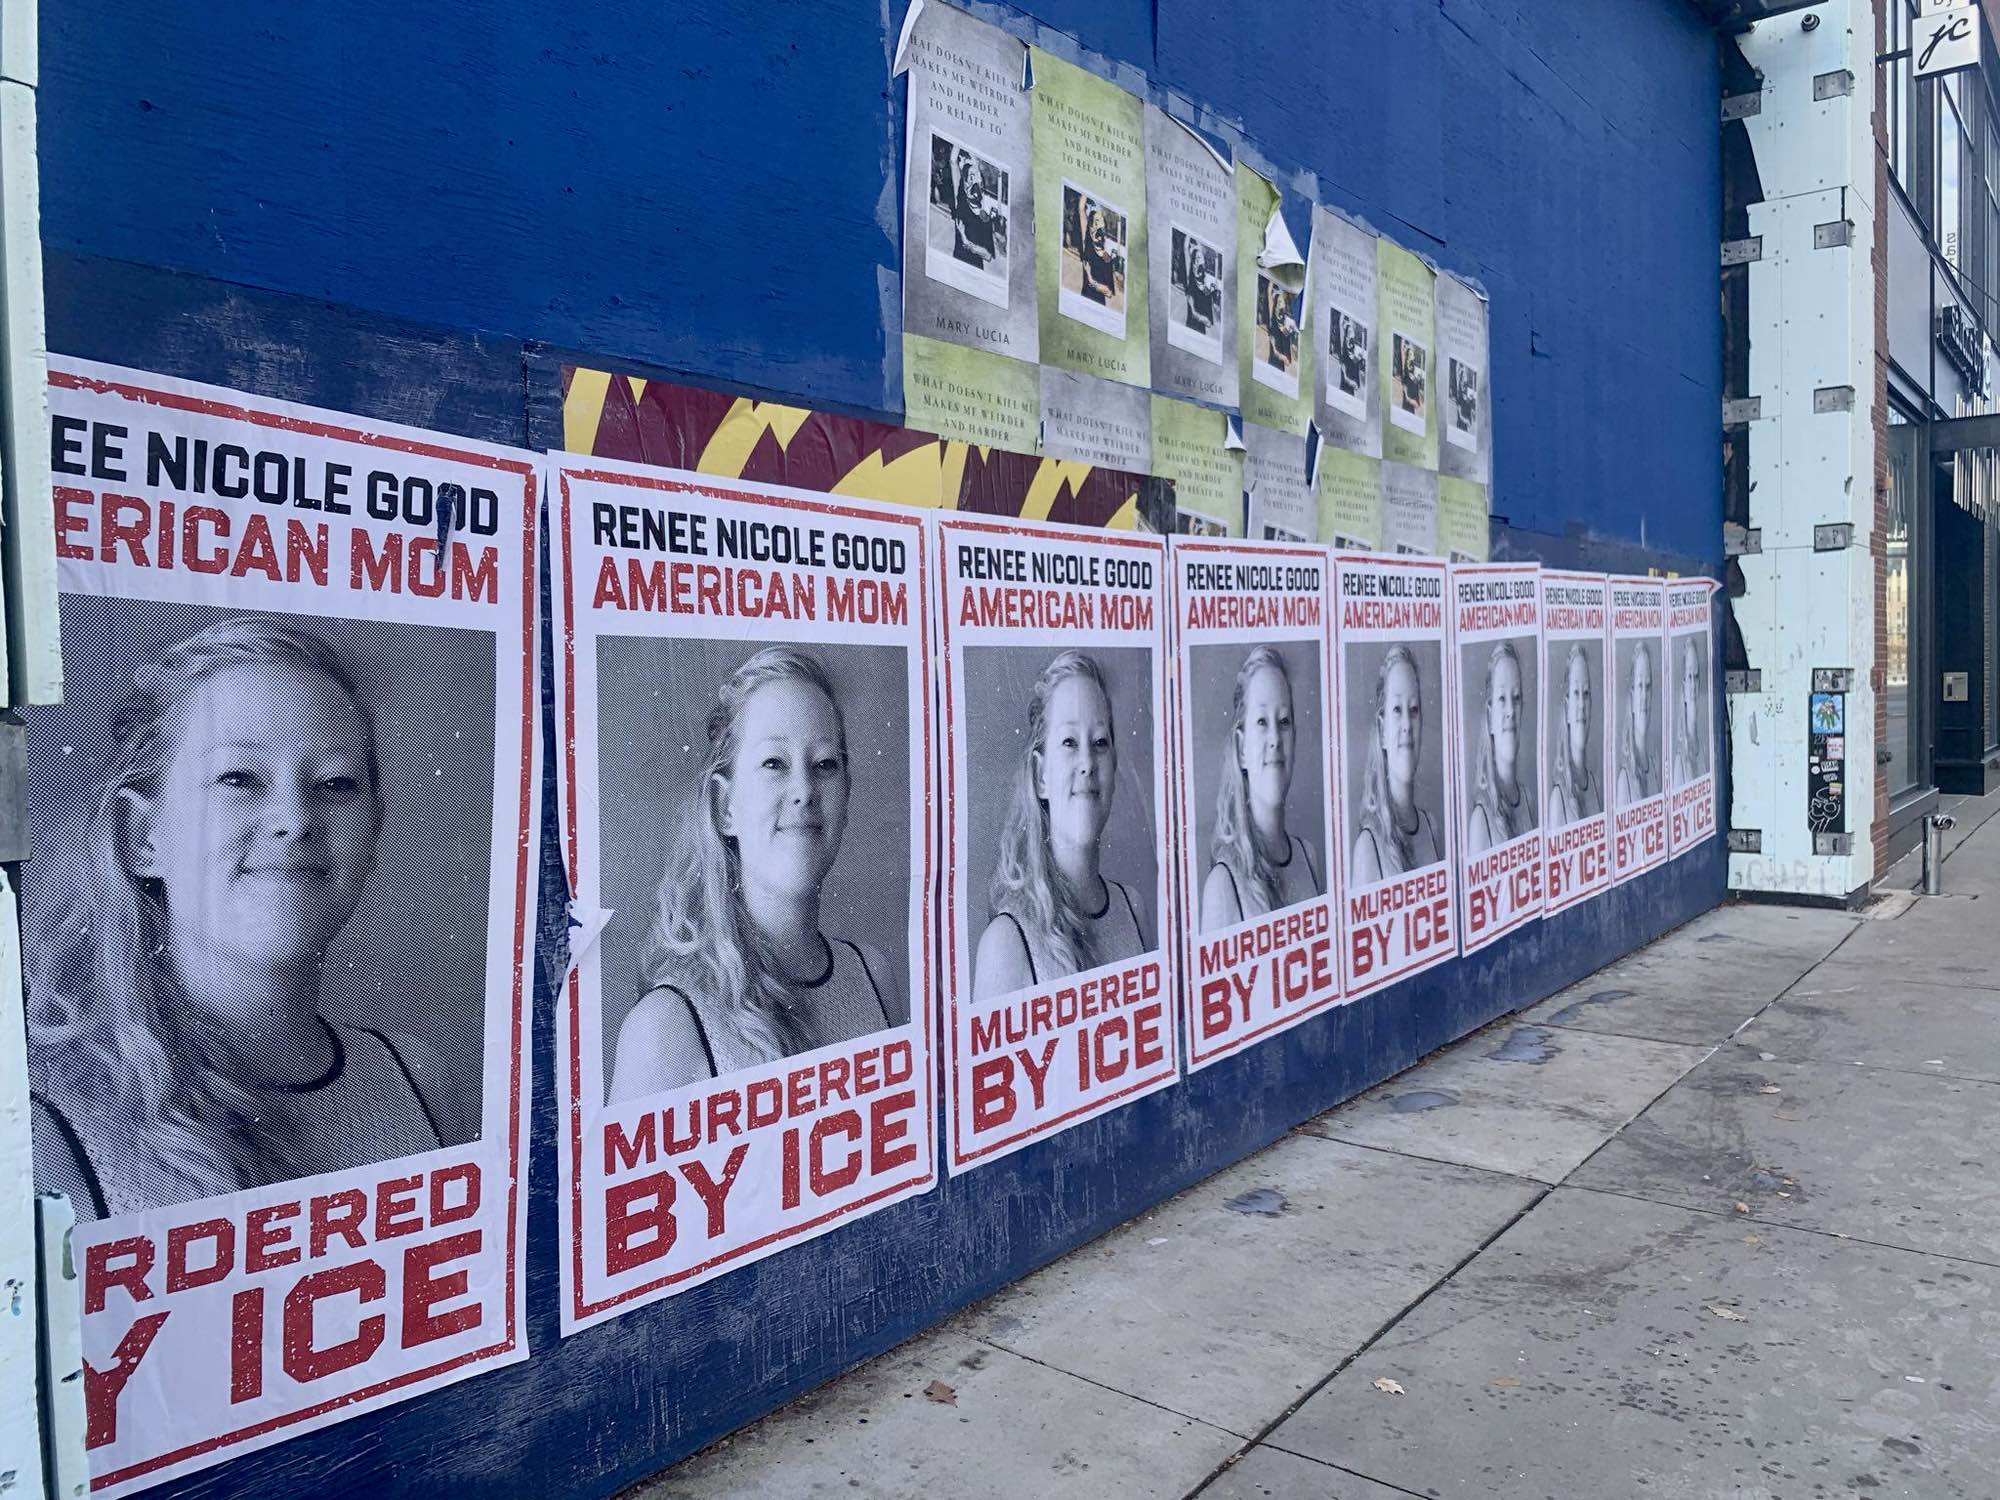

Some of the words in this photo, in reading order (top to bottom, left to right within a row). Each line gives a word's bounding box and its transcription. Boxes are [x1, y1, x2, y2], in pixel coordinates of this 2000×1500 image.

[910, 33, 931, 52] HAT
[936, 46, 981, 75] DOESN'T
[985, 69, 1006, 86] KILL
[911, 52, 947, 78] MAKES
[951, 71, 967, 86] ME
[970, 79, 1016, 109] WEIRDER
[930, 80, 953, 98] AND
[957, 91, 1000, 118] HARDER
[928, 96, 943, 112] TO
[947, 104, 985, 129] RELATE
[989, 122, 1002, 136] TO
[1038, 92, 1064, 112] WHAT
[1048, 113, 1077, 133] MAKES
[1095, 134, 1132, 158] WEIRDER
[1064, 138, 1082, 152] AND
[1084, 146, 1119, 168] HARDER
[1062, 152, 1073, 165] TO
[1076, 158, 1107, 179] RELATE
[1111, 172, 1121, 184] TO
[935, 316, 970, 335] MARY
[975, 326, 1010, 345] LUCIA
[1066, 349, 1095, 364] MARY
[1099, 355, 1127, 373] LUCIA
[913, 372, 944, 391] WHAT
[948, 383, 992, 403] DOESN'T
[996, 396, 1019, 409] KILL
[1021, 400, 1033, 413] ME
[1174, 374, 1197, 388] MARY
[1200, 380, 1224, 395] LUCIA
[923, 394, 960, 412] MAKES
[963, 405, 976, 417] ME
[981, 409, 1025, 428] WEIRDER
[943, 418, 965, 432] AND
[968, 424, 1009, 442] HARDER
[1047, 408, 1073, 421] WHAT
[1076, 415, 1113, 432] DOESN'T
[1056, 426, 1086, 442] MAKES
[1088, 434, 1099, 444] ME
[1103, 438, 1140, 455] WEIRDER
[1073, 447, 1090, 457] AND
[1092, 450, 1127, 465] HARDER
[147, 432, 352, 515] NICOLE
[53, 486, 328, 587] ERICAN
[350, 528, 498, 604] MOM
[592, 502, 708, 557] RENEE
[717, 519, 826, 567] NICOLE
[832, 533, 906, 574] GOOD
[958, 545, 1027, 582] RENEE
[1032, 552, 1100, 587] NICOLE
[1105, 558, 1152, 590] GOOD
[1187, 563, 1233, 591] RENEE
[1236, 565, 1283, 591] NICOLE
[1286, 567, 1320, 592] GOOD
[1343, 573, 1377, 597] RENEE
[1379, 575, 1413, 597] NICOLE
[1415, 577, 1441, 598] GOOD
[592, 556, 815, 621] AMERICAN
[826, 576, 908, 626] MOM
[960, 585, 1094, 629] AMERICAN
[1101, 593, 1153, 631] MOM
[1458, 582, 1485, 604] RENEE
[1486, 581, 1513, 602] NICOLE
[1513, 580, 1535, 599] GOOD
[1545, 587, 1565, 606] RENEE
[1565, 588, 1585, 606] NICOLE
[1586, 589, 1604, 606] GOOD
[1187, 596, 1279, 629] AMERICAN
[1283, 596, 1320, 627] MOM
[1343, 601, 1410, 629] AMERICAN
[1413, 602, 1441, 629] MOM
[1460, 604, 1513, 633] AMERICAN
[1513, 602, 1537, 627] MOM
[1546, 608, 1584, 630] AMERICAN
[1585, 608, 1603, 630] MOM
[1672, 778, 1712, 811] MURDERED
[1616, 799, 1663, 833] MURDERED
[1673, 808, 1689, 845] BY
[1693, 797, 1712, 832] ICE
[1547, 819, 1605, 858] MURDERED
[1616, 830, 1637, 869] BY
[1641, 819, 1664, 856] ICE
[1468, 836, 1540, 888] MURDERED
[1549, 855, 1573, 898] BY
[1579, 842, 1606, 886] ICE
[1350, 869, 1447, 925] MURDERED
[1469, 879, 1501, 934] BY
[1508, 861, 1542, 914] ICE
[1199, 904, 1329, 978] MURDERED
[1352, 918, 1394, 978] BY
[1404, 898, 1450, 956] ICE
[971, 962, 1161, 1057] MURDERED
[1201, 964, 1259, 1041] BY
[1271, 938, 1332, 1009] ICE
[972, 1037, 1060, 1135] BY
[1077, 1002, 1163, 1092] ICE
[604, 1039, 913, 1176] MURDERED
[605, 1142, 750, 1277] BY
[782, 1089, 917, 1210] ICE
[85, 1162, 481, 1315] RDERED
[82, 1311, 171, 1450] Y
[230, 1229, 482, 1405] ICE
